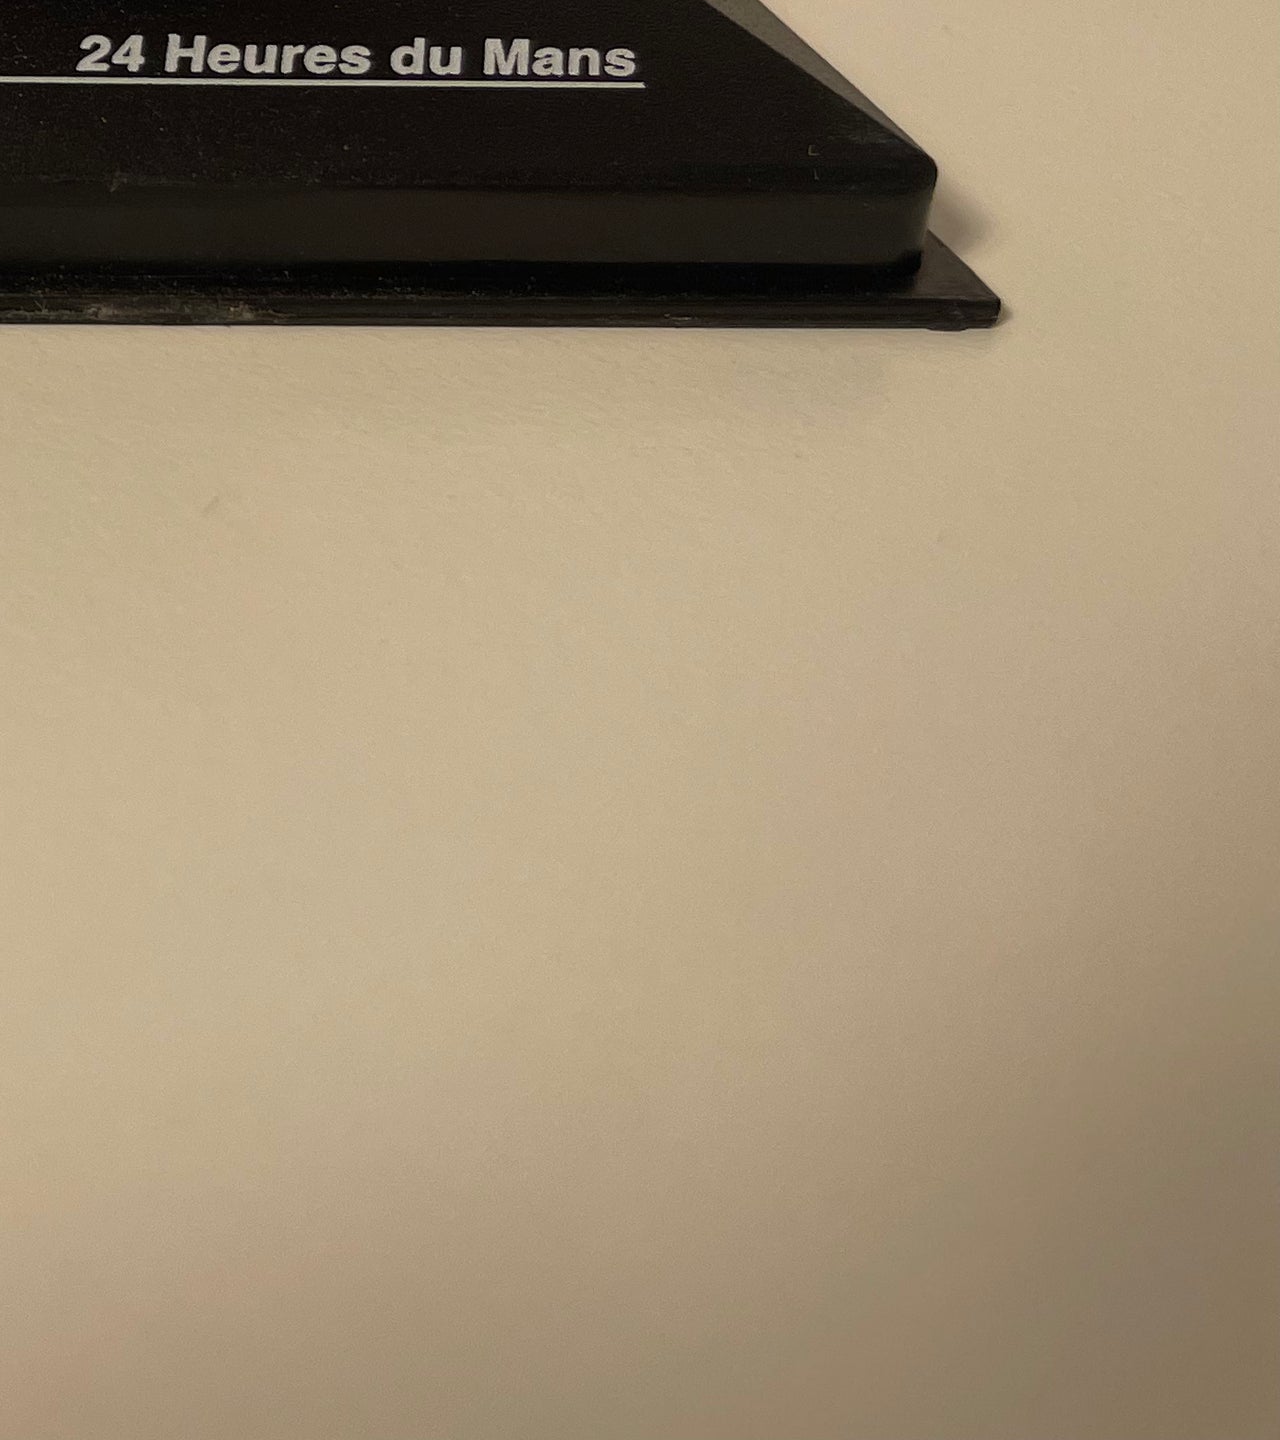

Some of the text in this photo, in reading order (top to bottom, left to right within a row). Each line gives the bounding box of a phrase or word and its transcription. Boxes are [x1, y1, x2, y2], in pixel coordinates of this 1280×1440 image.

[75, 33, 637, 78] 24 Heures du Mans
